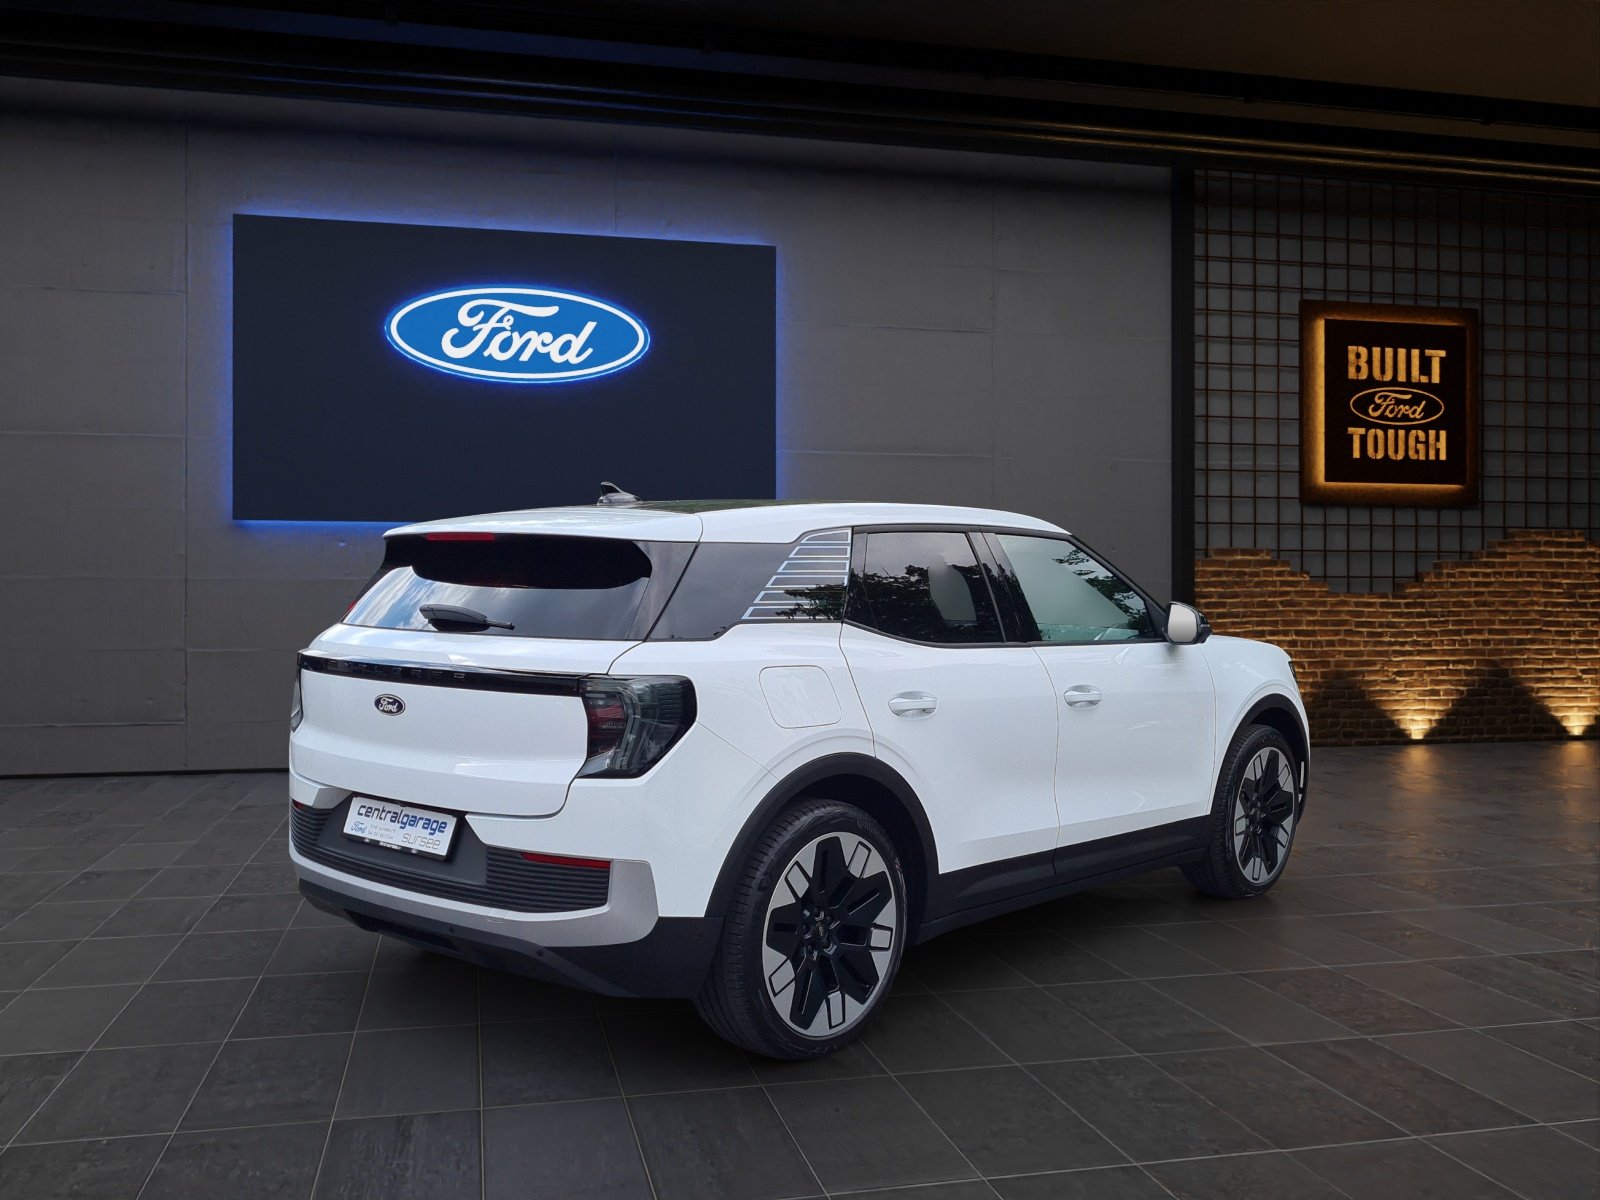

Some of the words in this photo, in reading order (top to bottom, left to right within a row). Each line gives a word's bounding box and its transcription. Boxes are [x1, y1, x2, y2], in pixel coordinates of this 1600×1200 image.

[441, 299, 597, 364] Ford
[1347, 345, 1446, 383] BUILT
[1368, 391, 1426, 419] Ford
[1347, 427, 1447, 461] TOUGH
[379, 697, 398, 712] Ford
[350, 821, 368, 834] Ford
[357, 804, 447, 835] centralgarage
[401, 833, 441, 850] sursee
